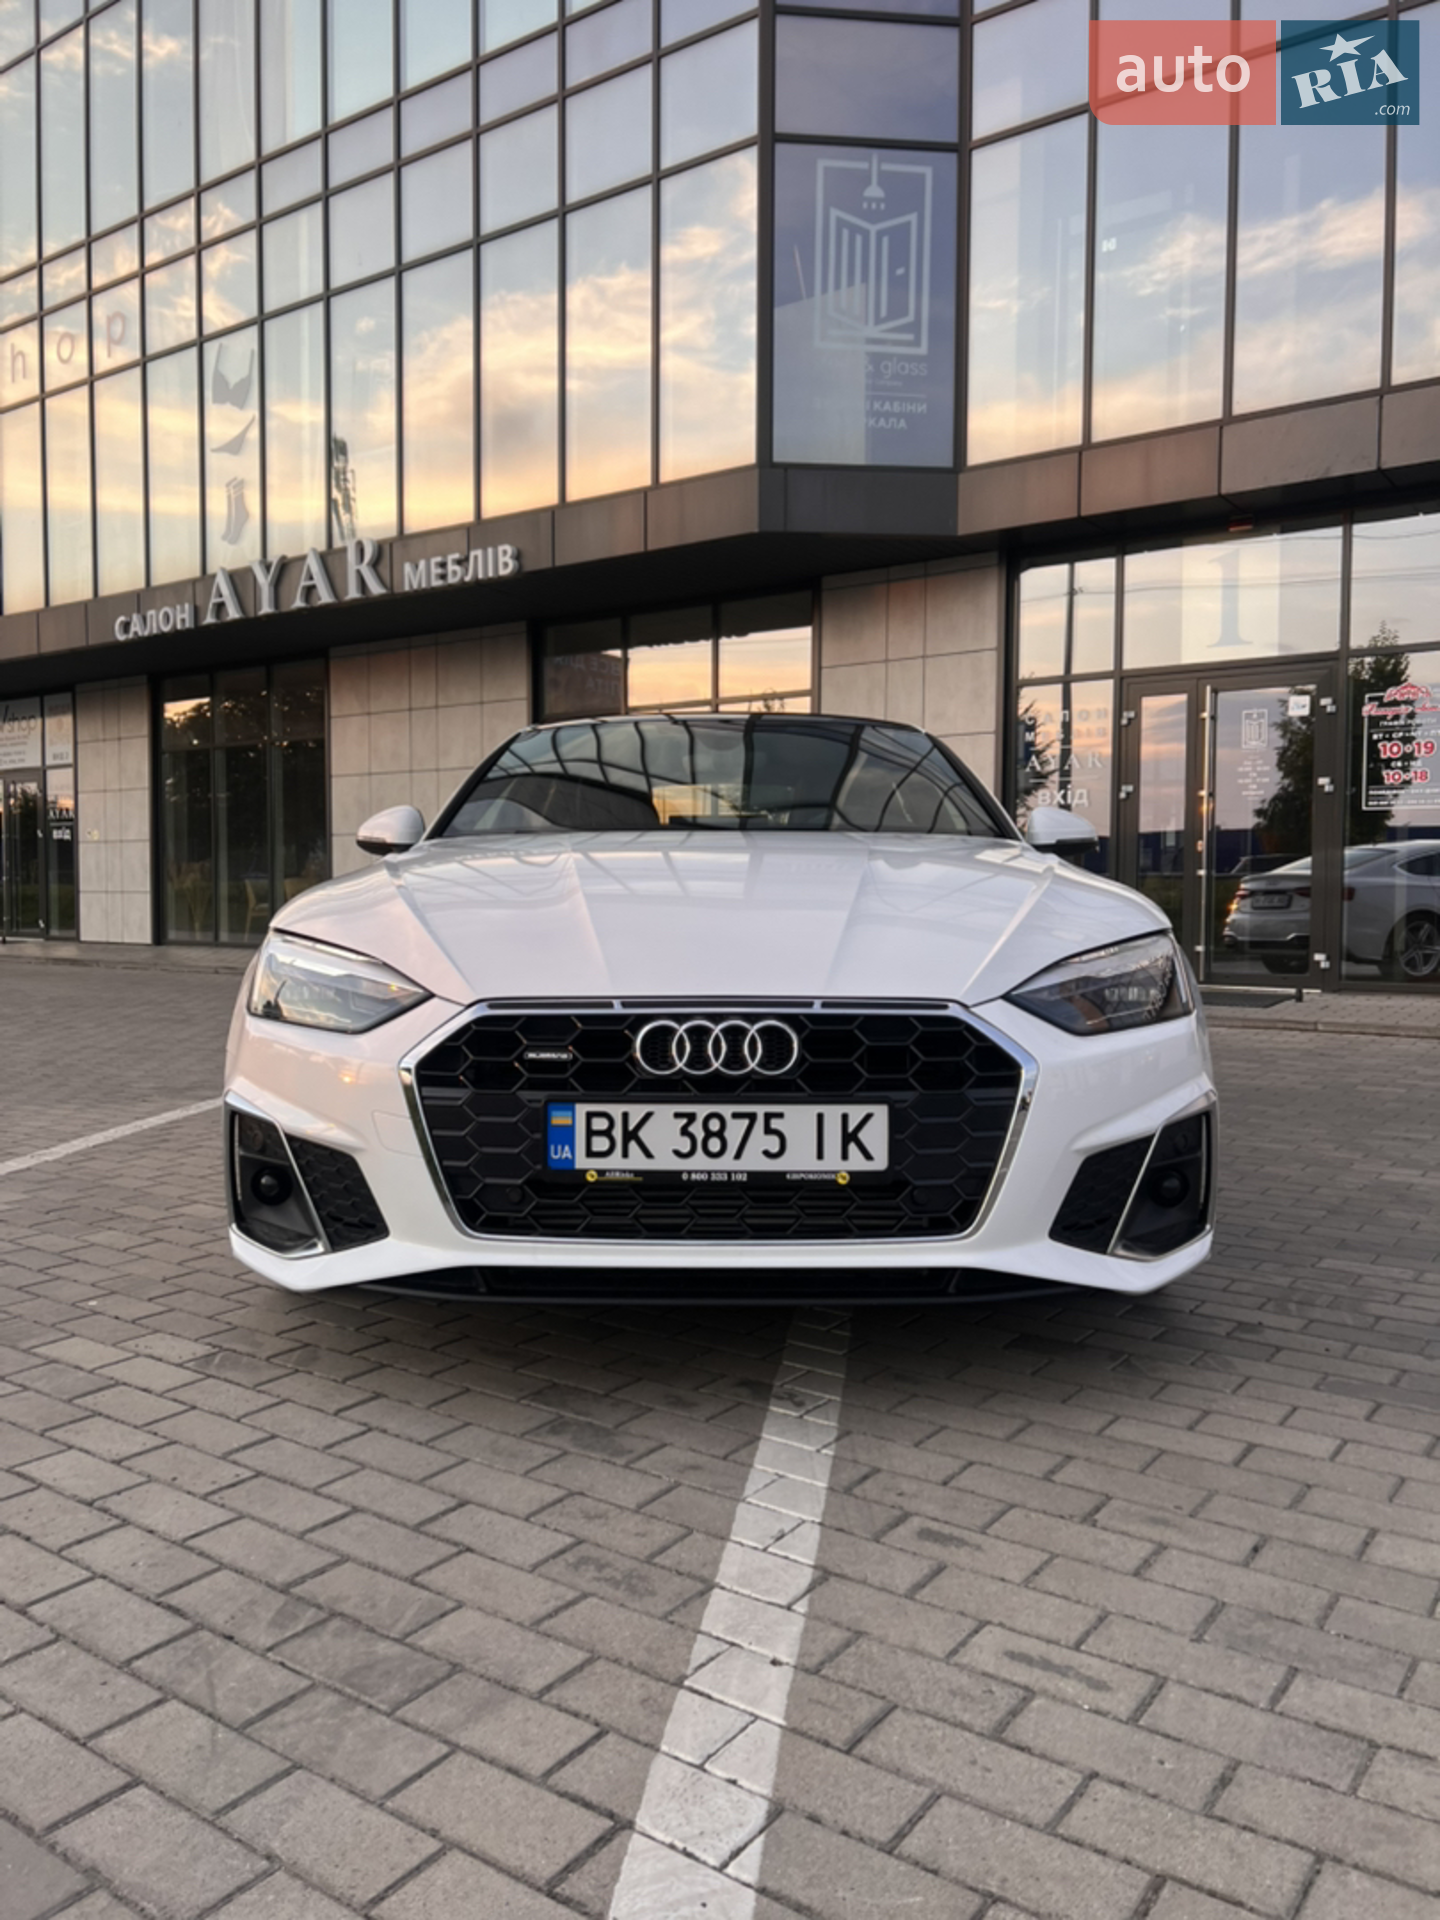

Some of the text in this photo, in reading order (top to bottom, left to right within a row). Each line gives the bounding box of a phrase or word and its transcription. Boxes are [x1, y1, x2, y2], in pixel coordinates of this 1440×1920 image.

[880, 357, 928, 379] glass
[873, 401, 928, 415] КАБІНИ
[114, 538, 521, 641] САЛОН AYAR МЕБЛІВ
[1377, 738, 1437, 759] 10 19
[1025, 750, 1103, 773] AYAR
[1382, 768, 1430, 785] 10 18
[551, 1110, 875, 1161] UA BK 3875 IK
